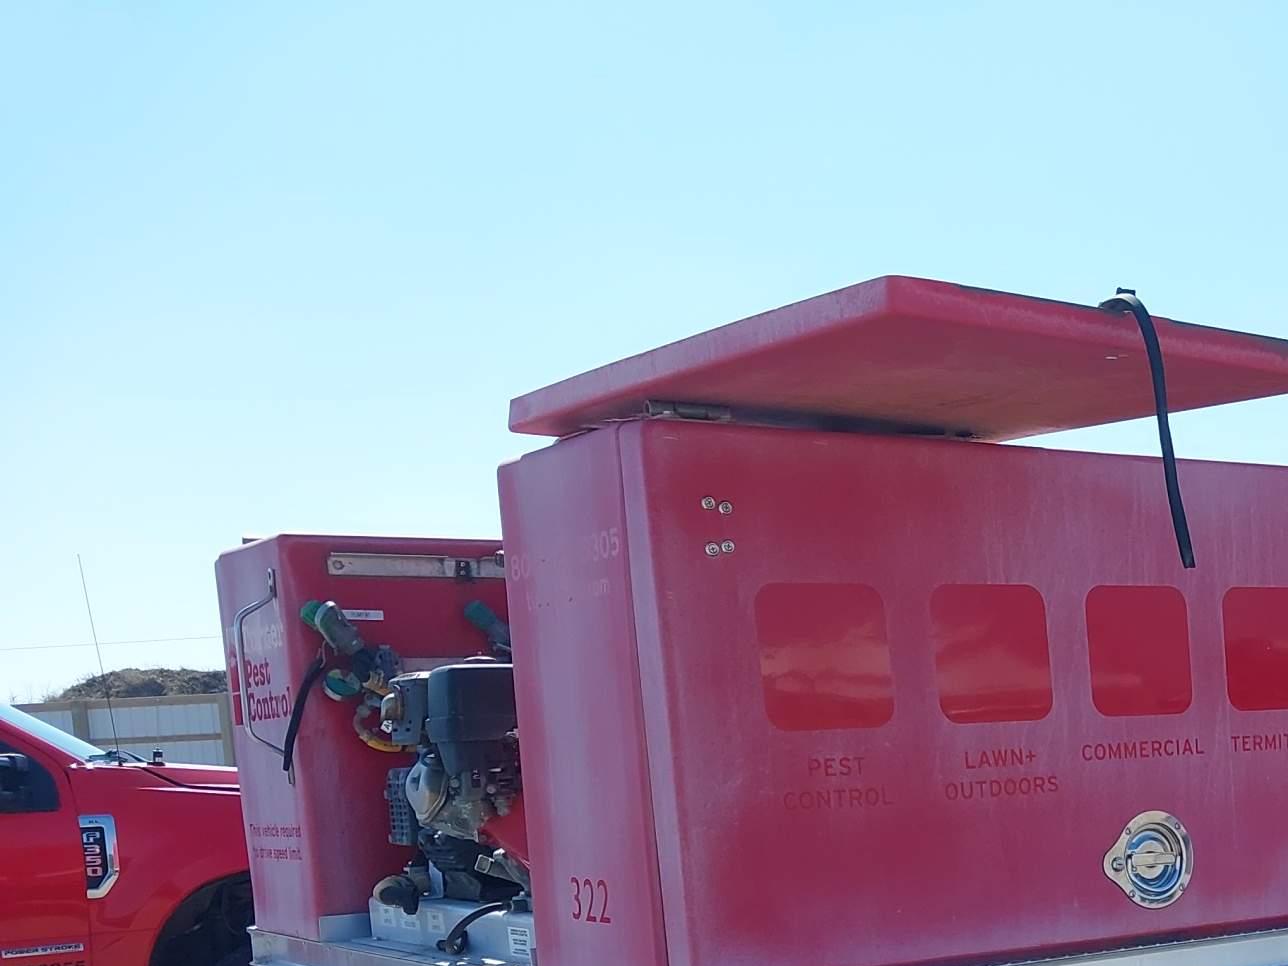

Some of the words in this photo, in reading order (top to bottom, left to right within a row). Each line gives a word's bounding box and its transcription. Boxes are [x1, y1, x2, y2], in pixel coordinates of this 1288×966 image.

[244, 657, 271, 688] Pest
[248, 686, 293, 722] Control
[964, 747, 1037, 769] LAWN+
[1081, 738, 1205, 762] COMMERCIAL
[807, 756, 865, 777] PEST
[783, 785, 894, 811] CONTROL
[945, 775, 1059, 801] OUTDOORS
[82, 831, 103, 877] F350
[570, 876, 611, 924] 322
